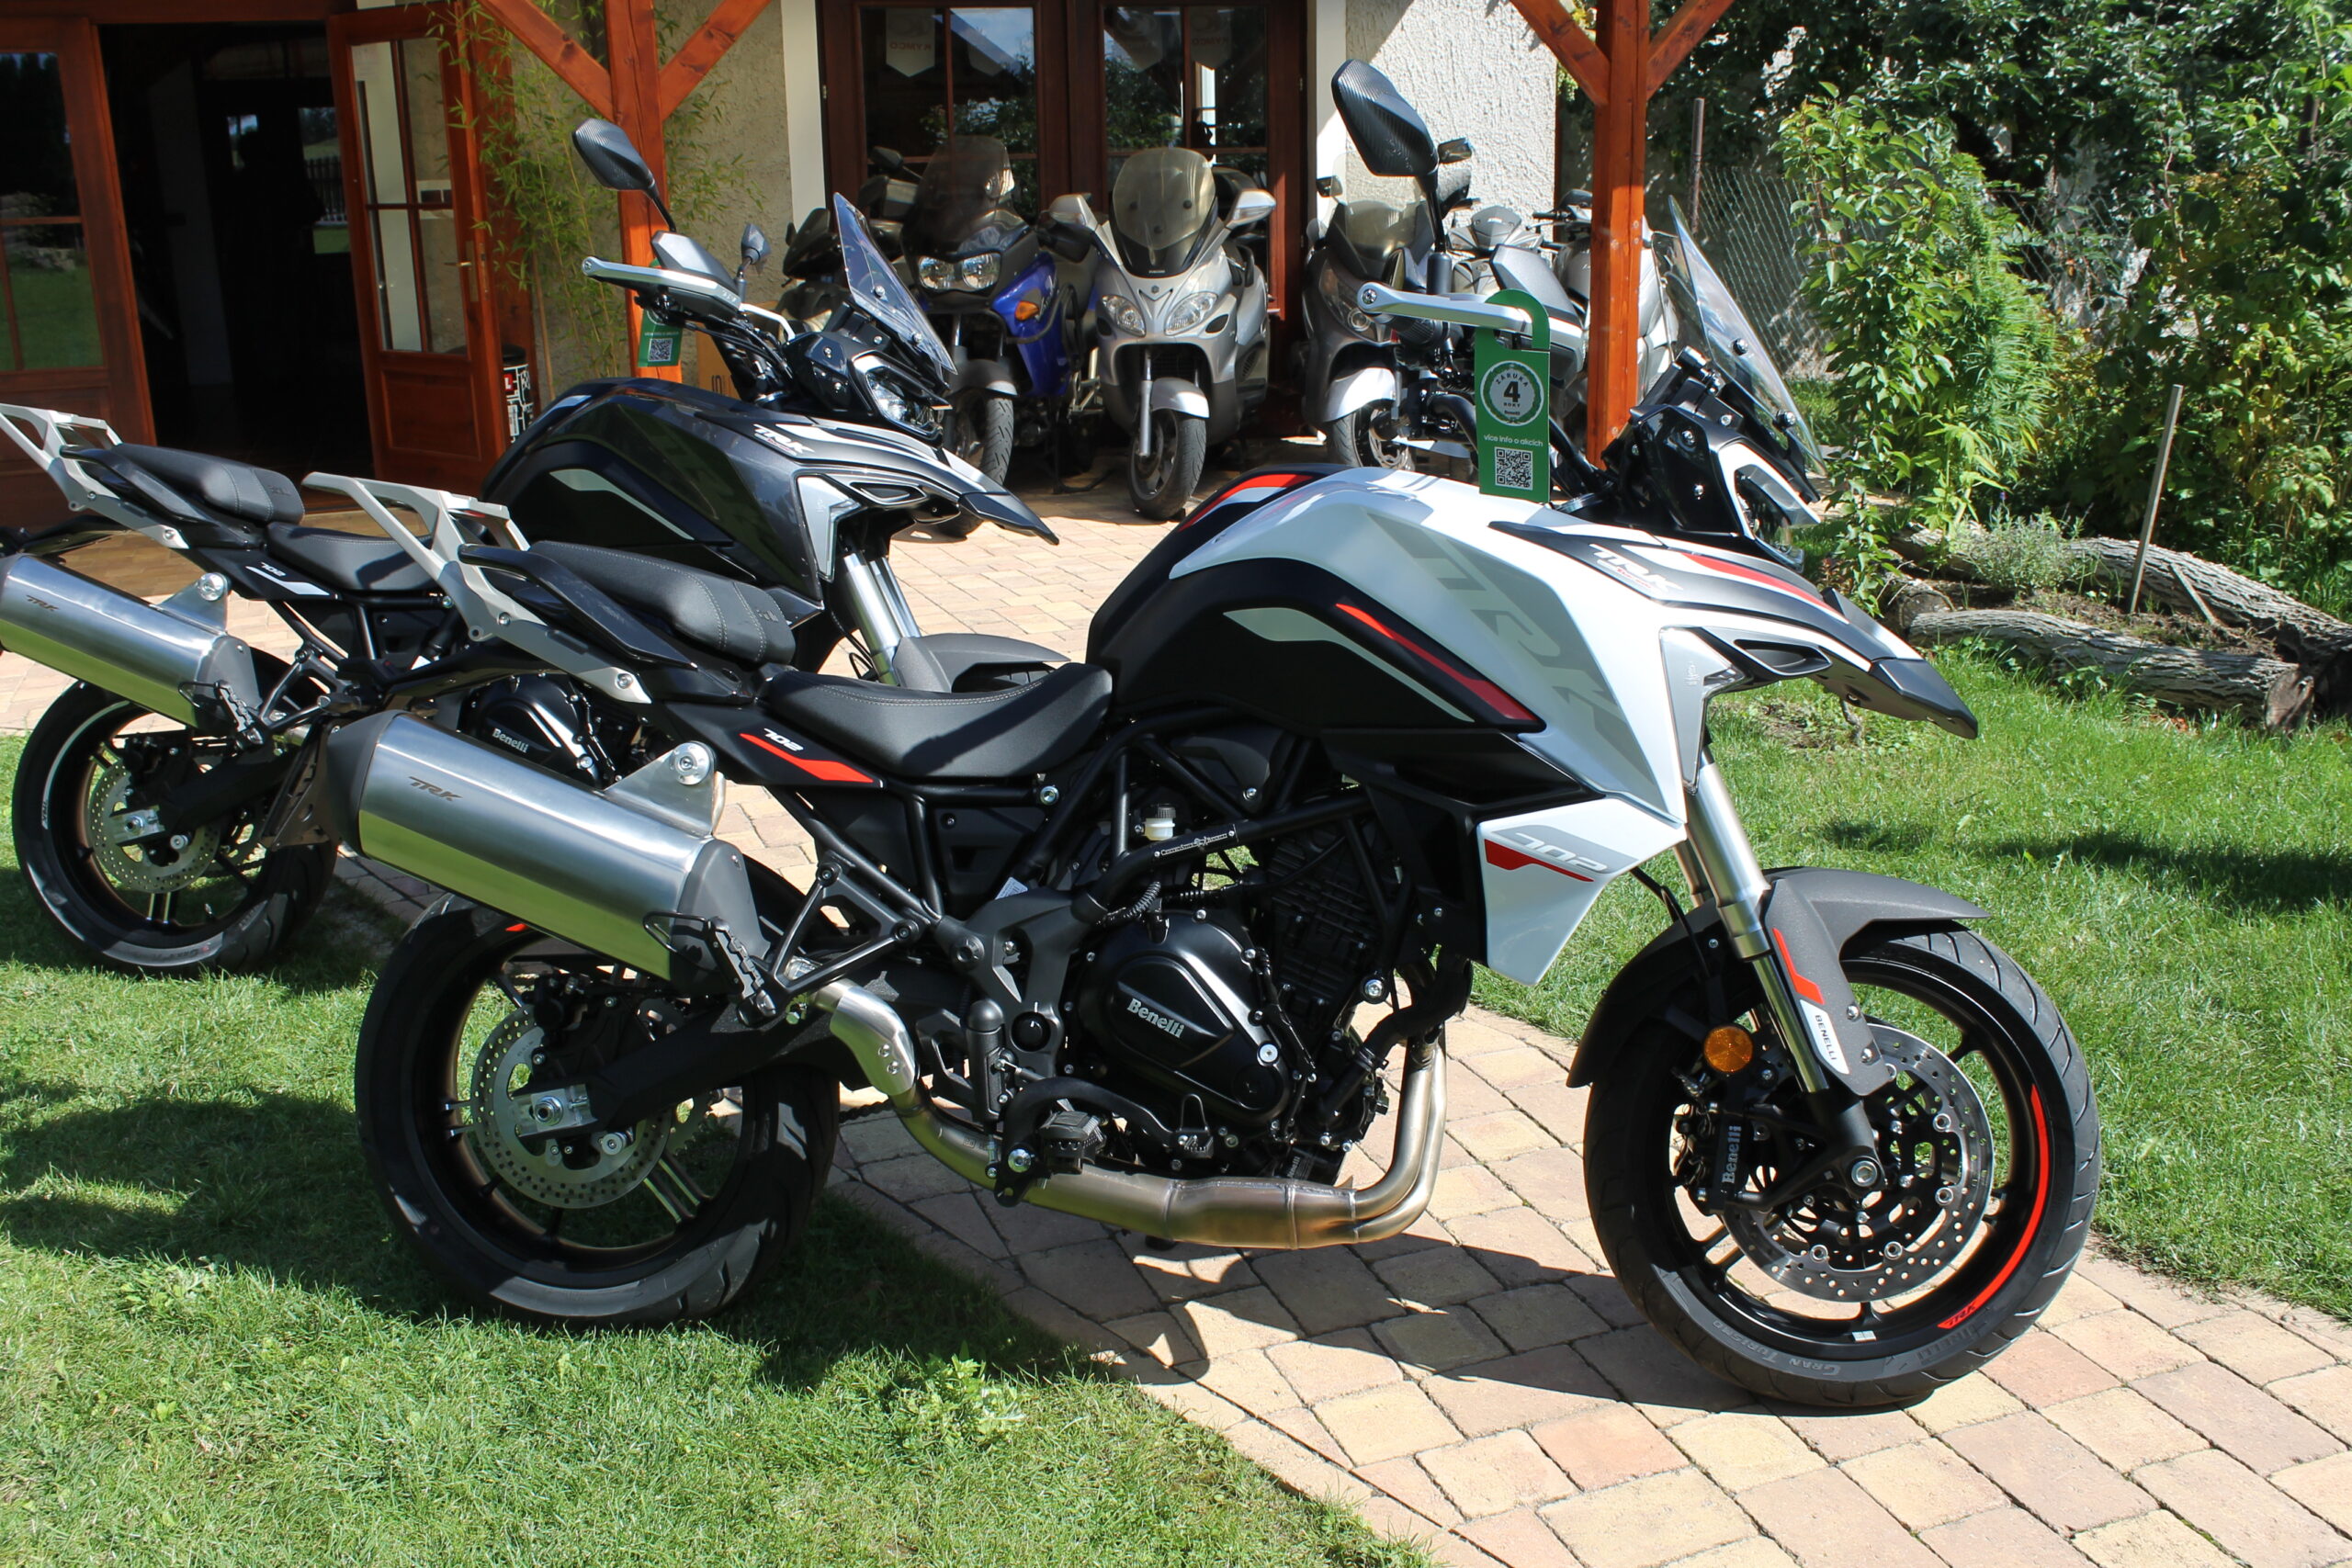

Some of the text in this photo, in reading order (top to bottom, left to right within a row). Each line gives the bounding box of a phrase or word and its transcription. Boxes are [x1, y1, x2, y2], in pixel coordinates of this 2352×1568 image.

[1503, 380, 1521, 402] 4
[753, 423, 815, 454] TRK
[260, 561, 286, 577] 702
[1589, 543, 1683, 592] TRK
[26, 594, 60, 612] TRK
[492, 728, 529, 753] Benelli
[763, 728, 804, 751] 702
[408, 776, 463, 802] TRK
[1516, 832, 1608, 871] 702
[1126, 998, 1185, 1039] Benelli
[1815, 1014, 1838, 1060] BENELLI
[1721, 1125, 1742, 1184] Benelli
